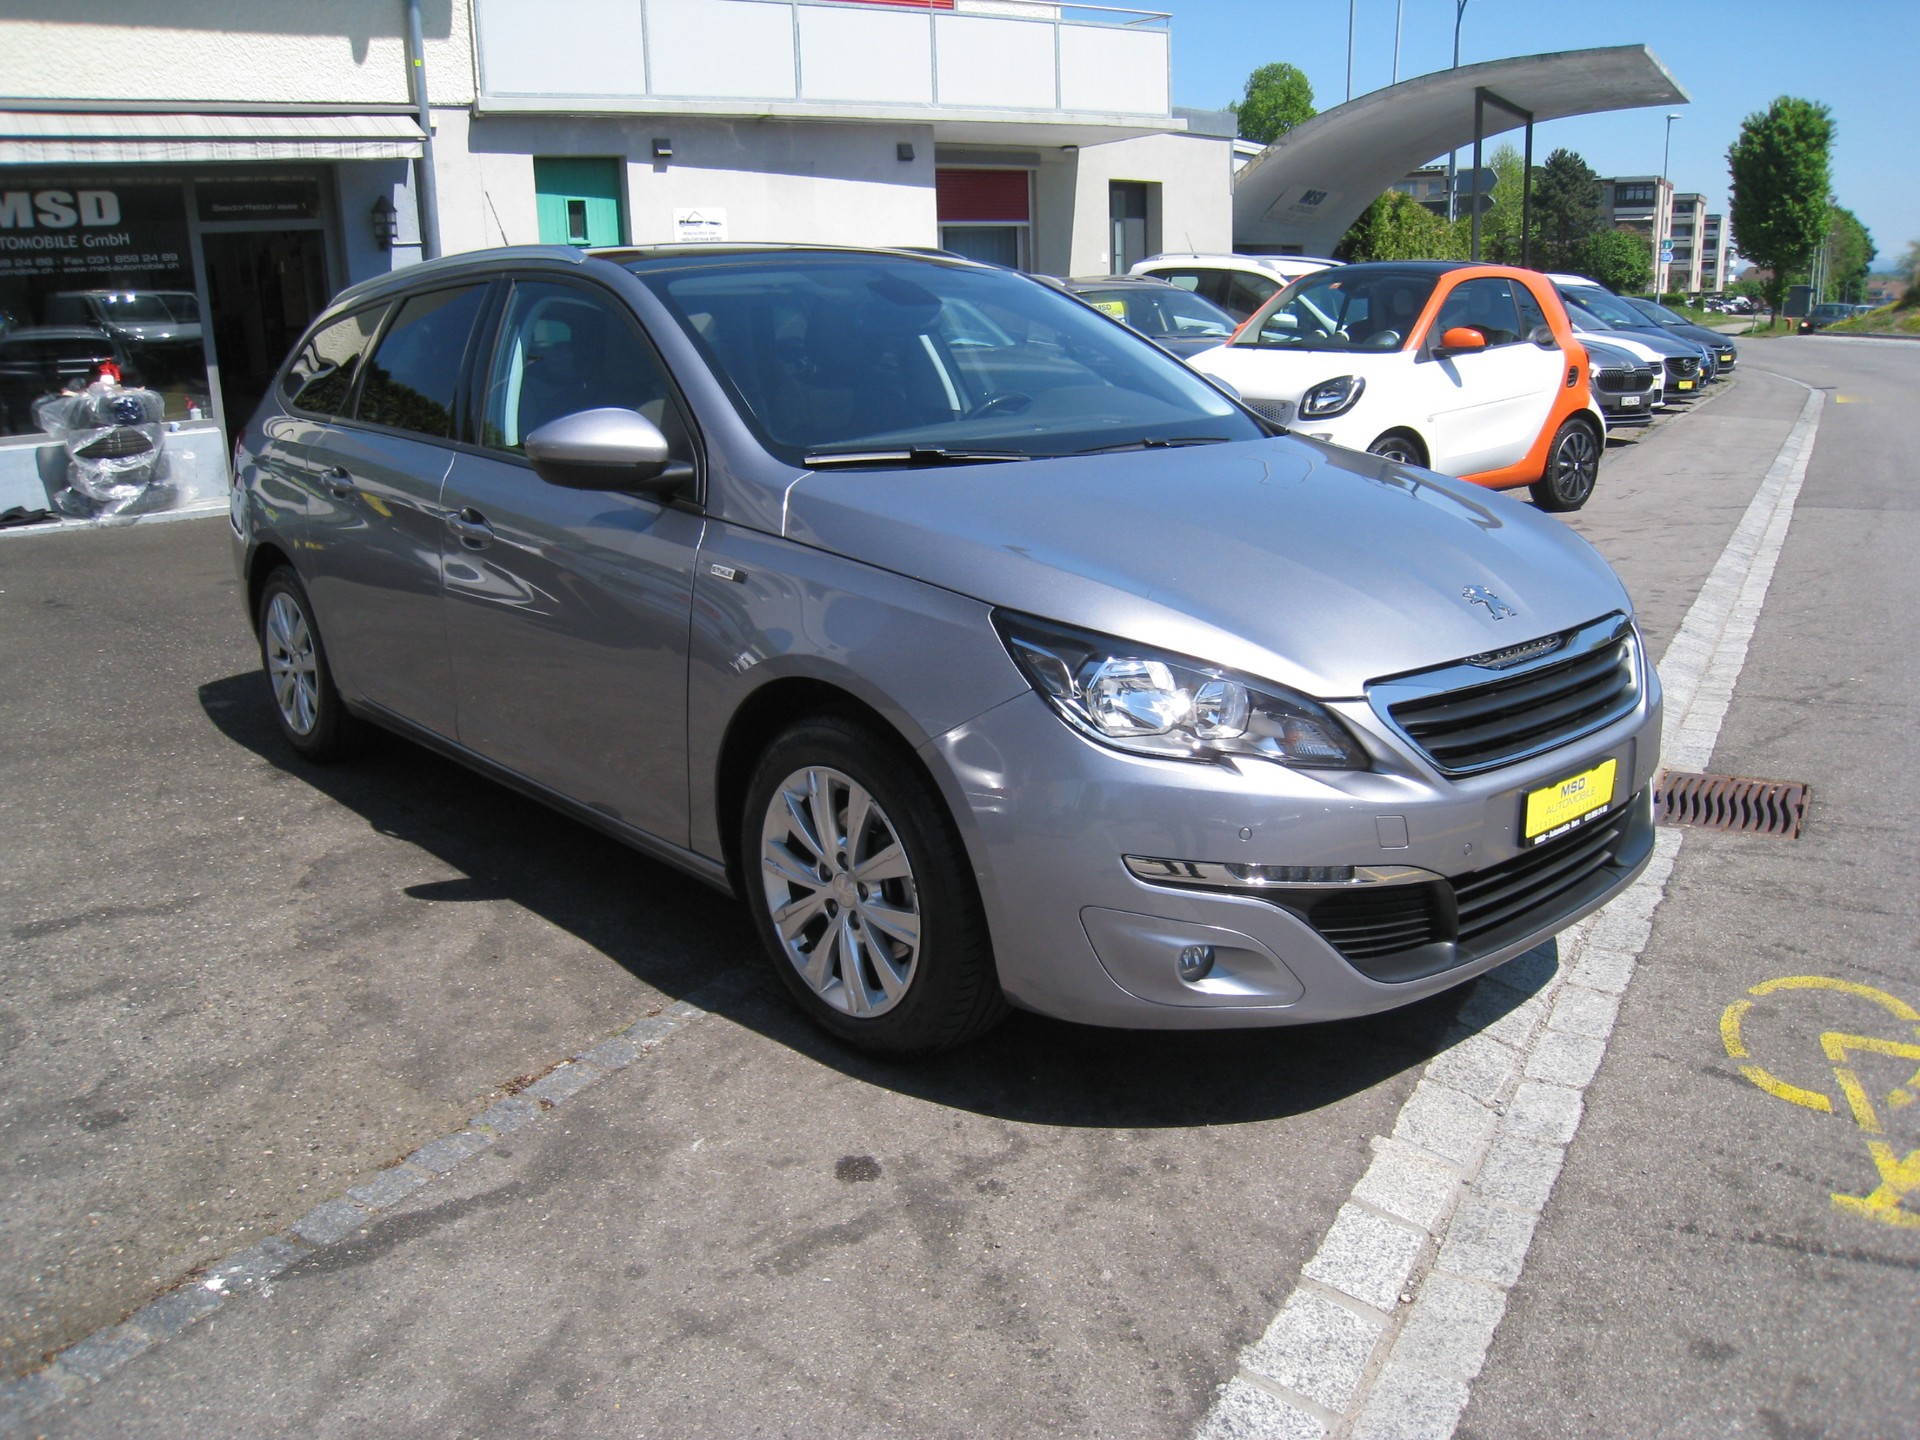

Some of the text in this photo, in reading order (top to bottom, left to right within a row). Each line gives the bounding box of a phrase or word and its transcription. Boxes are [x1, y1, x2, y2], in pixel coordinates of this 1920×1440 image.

[0, 190, 121, 228] MSD
[83, 232, 131, 248] GmbH
[63, 255, 85, 265] Fax
[87, 254, 110, 264] 031
[115, 253, 140, 263] 859
[142, 253, 159, 263] 24
[1560, 777, 1586, 799] MSD
